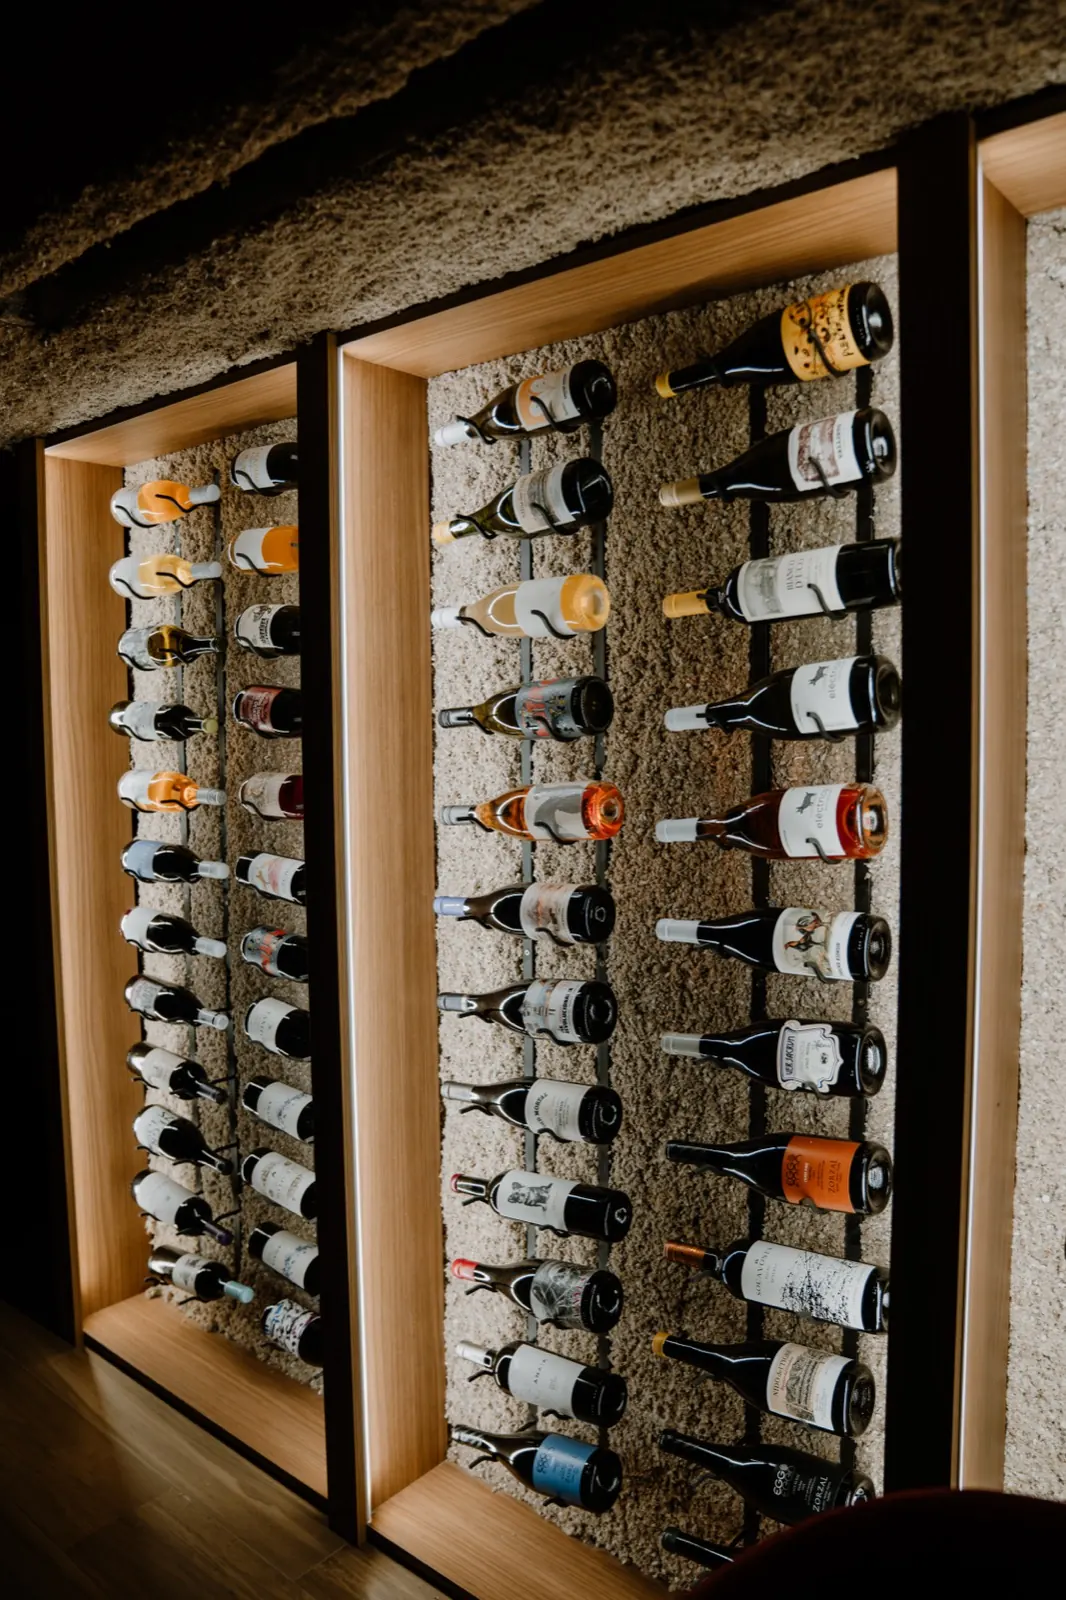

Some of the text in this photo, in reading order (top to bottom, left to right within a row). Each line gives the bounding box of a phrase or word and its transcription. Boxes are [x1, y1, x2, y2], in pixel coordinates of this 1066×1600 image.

[785, 559, 795, 591] BIANCO
[828, 1160, 838, 1193] ZORZAL
[812, 1476, 828, 1512] ZORZAL
